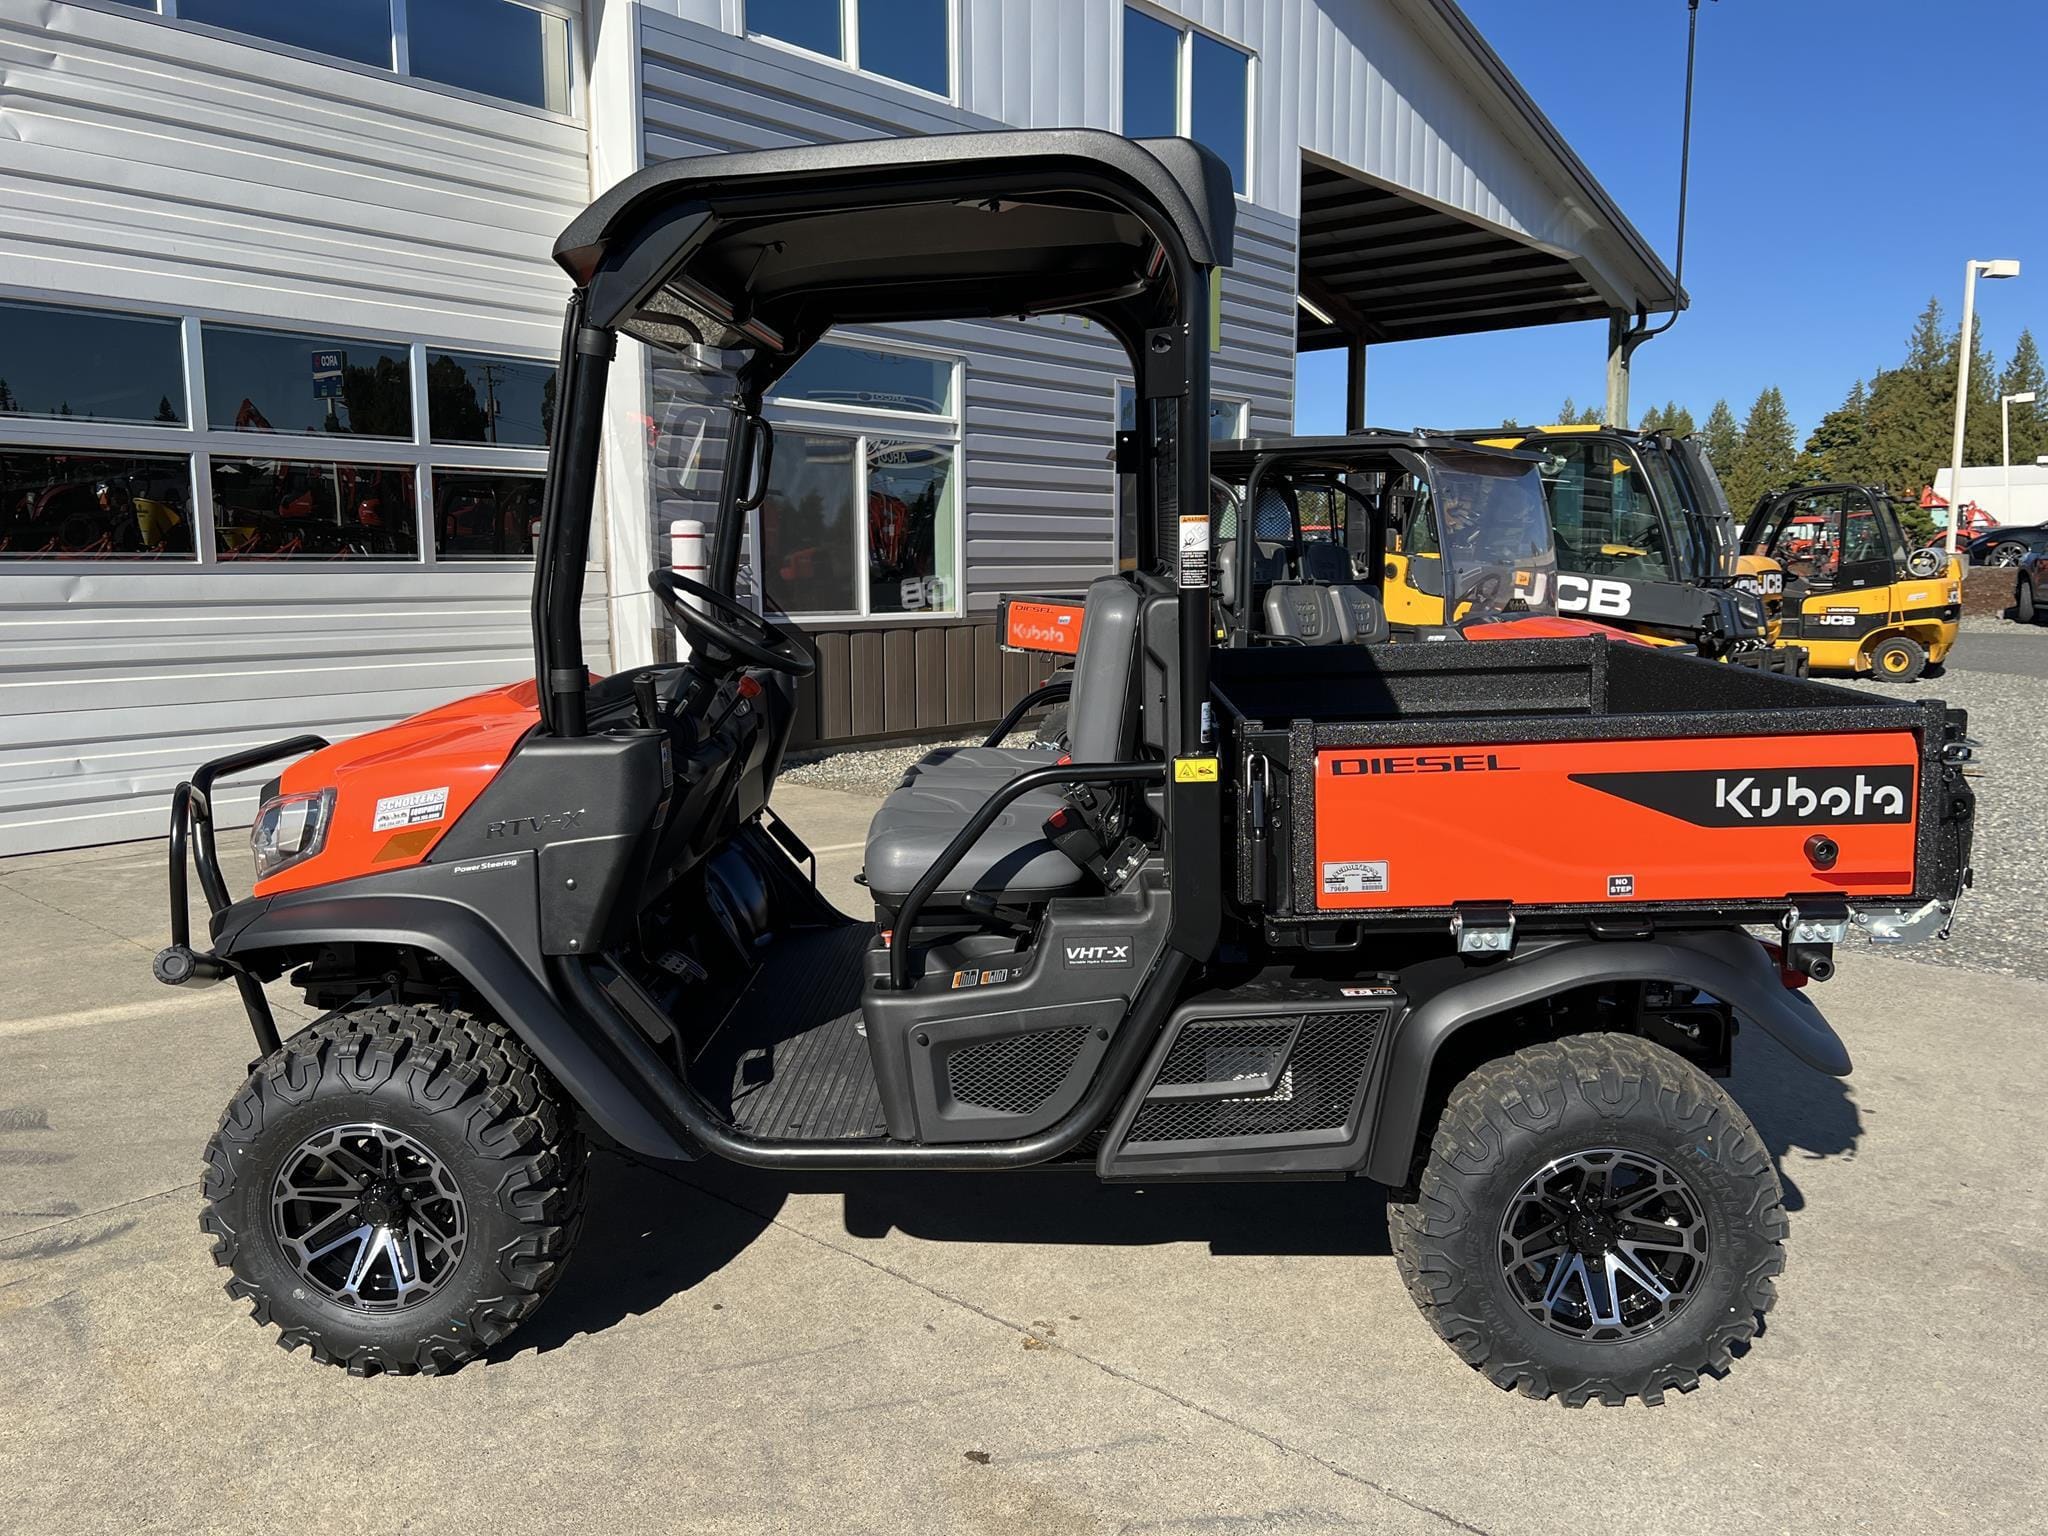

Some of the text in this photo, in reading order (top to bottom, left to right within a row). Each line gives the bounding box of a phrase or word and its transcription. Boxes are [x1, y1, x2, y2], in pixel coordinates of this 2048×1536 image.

[1758, 574, 1782, 594] JCB
[1514, 573, 1632, 616] JCB
[1015, 605, 1055, 614] DIESEL
[1820, 615, 1856, 625] JCB
[1013, 622, 1065, 643] Kubota
[1331, 754, 1520, 776] DIESEL
[379, 791, 445, 812] SCHOLTEN'S
[1715, 774, 1904, 819] Kubota
[487, 808, 585, 839] RTV-X
[454, 859, 517, 873] Power Steering
[1610, 885, 1632, 893] STEP
[1066, 946, 1129, 959] VHT-X
